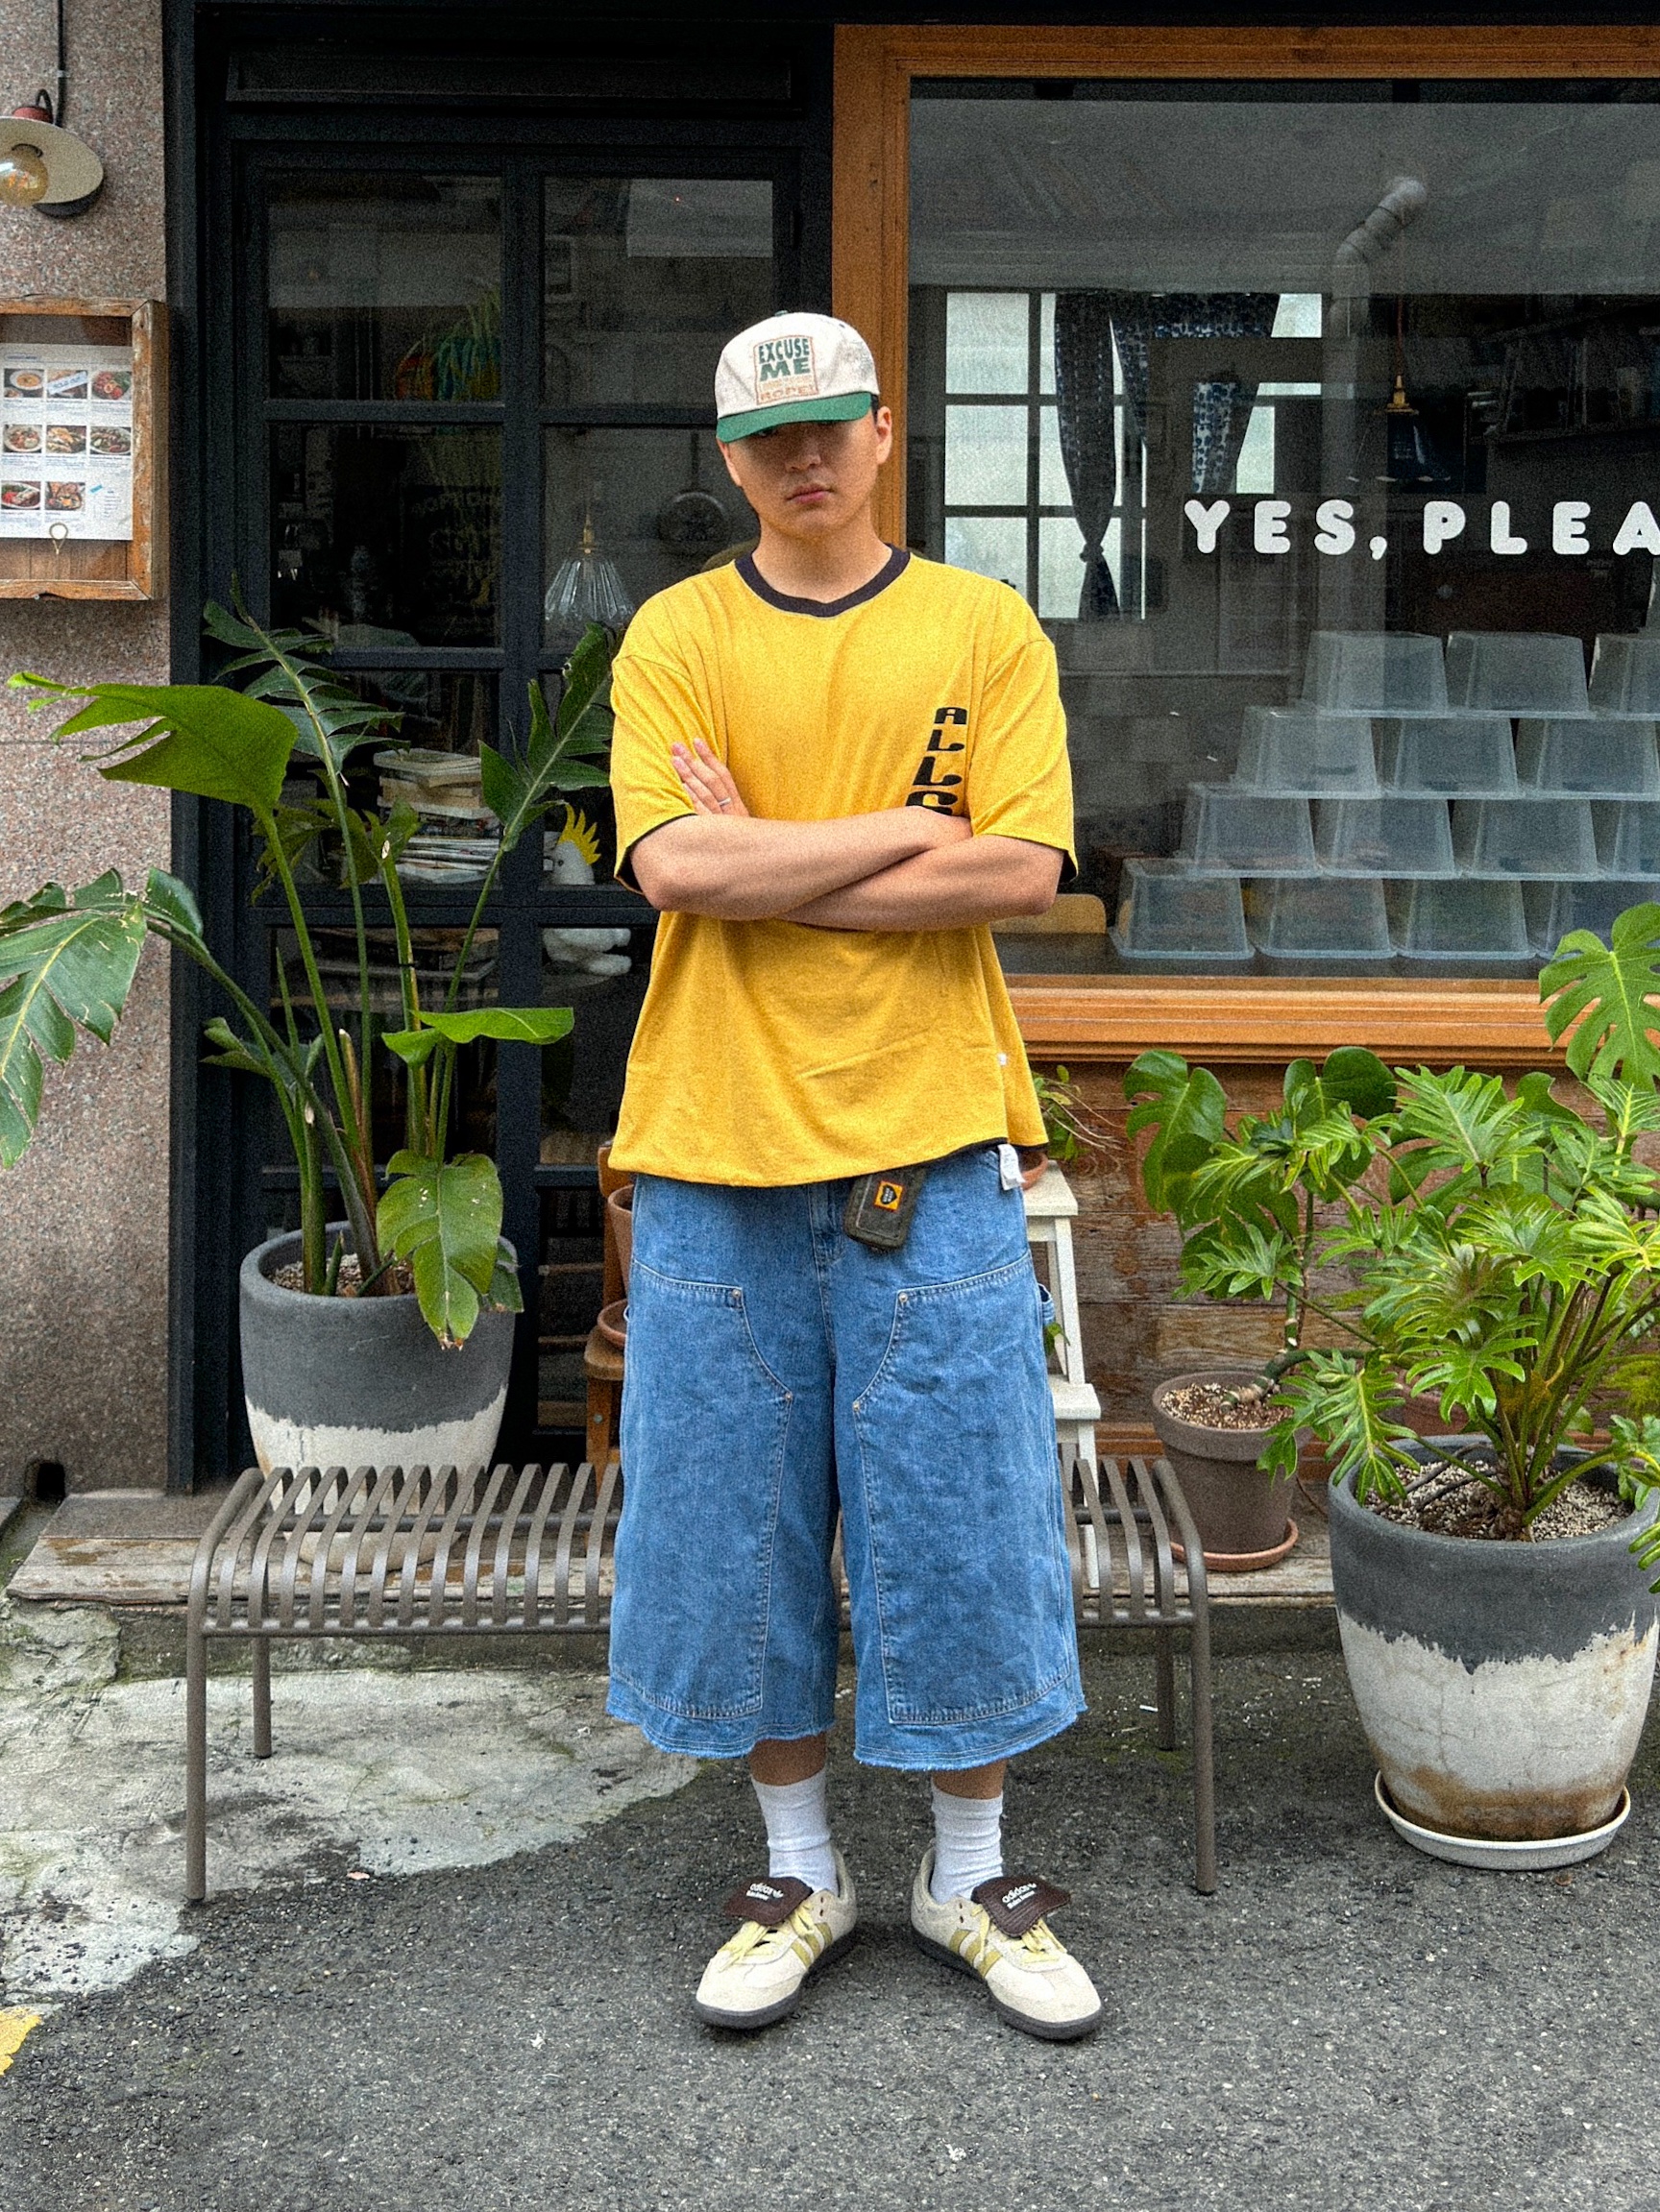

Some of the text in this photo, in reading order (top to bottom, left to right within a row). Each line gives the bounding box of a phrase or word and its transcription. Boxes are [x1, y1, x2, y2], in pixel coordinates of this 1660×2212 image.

[758, 338, 810, 364] EXCUSE
[760, 357, 811, 381] ME
[1184, 499, 1660, 560] YES, PLEA
